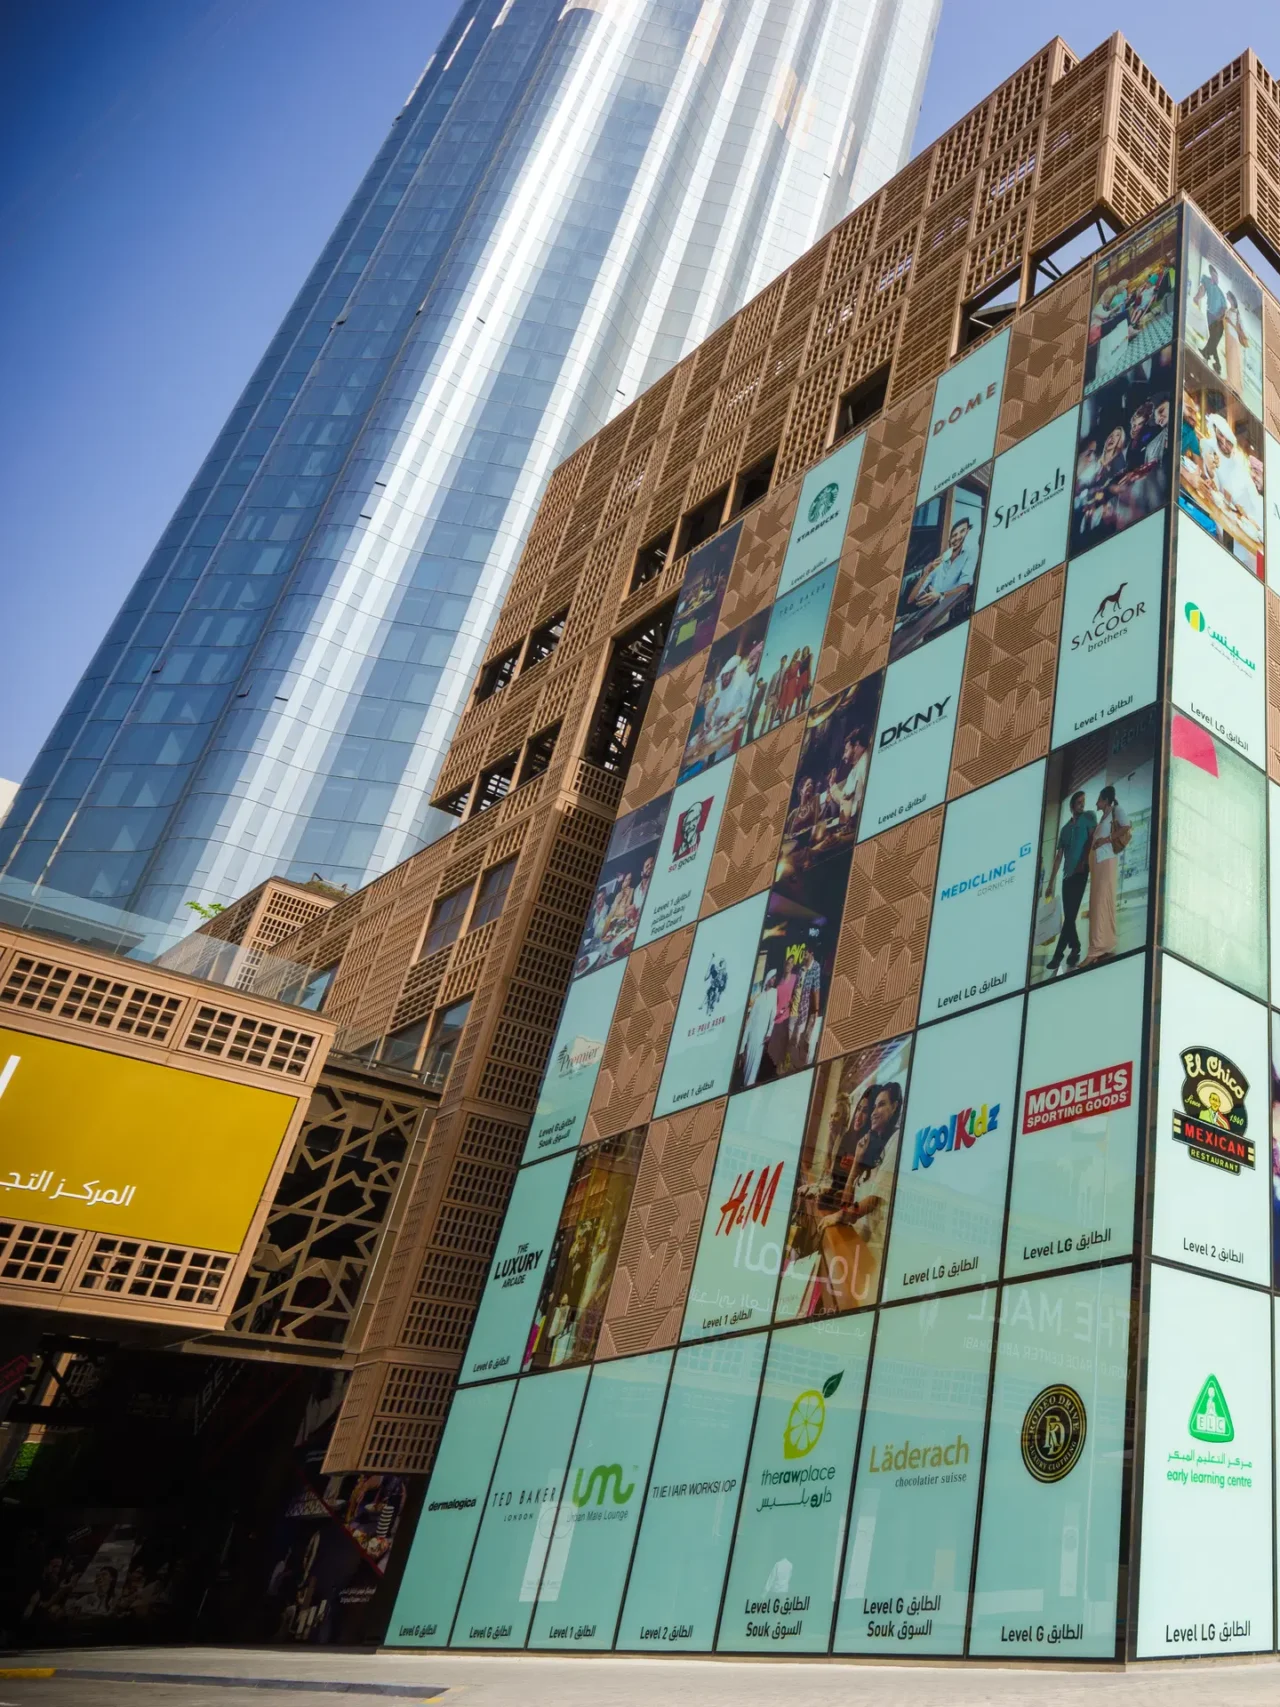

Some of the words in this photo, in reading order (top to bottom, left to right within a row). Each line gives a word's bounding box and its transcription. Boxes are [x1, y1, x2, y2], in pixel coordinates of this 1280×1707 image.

[933, 382, 997, 436] DOME
[992, 467, 1065, 529] Splash
[796, 511, 839, 544] STARBUCKS
[996, 577, 1016, 593] Level
[1071, 601, 1147, 651] SACOOR
[1088, 627, 1128, 652] brothers
[879, 695, 952, 749] DKNY
[1074, 714, 1098, 731] Level
[1107, 695, 1133, 716] الطابق
[1190, 702, 1213, 726] Level
[1215, 719, 1225, 736] LG
[1226, 730, 1249, 752] الطابق
[878, 809, 897, 825] Level
[905, 793, 927, 812] الطابق
[668, 864, 677, 873] so
[677, 853, 697, 871] good
[940, 860, 1016, 901] MEDICLINIC
[977, 876, 1016, 897] CORNICHE
[937, 990, 962, 1008] Level
[964, 985, 977, 999] LG
[979, 972, 1008, 994] الطابق
[560, 1046, 600, 1072] Premier
[1184, 1053, 1205, 1078] El
[1206, 1056, 1245, 1099] Chico
[673, 1088, 690, 1103] Level
[695, 1080, 715, 1096] الطابق
[1027, 1068, 1128, 1116] MODELL'S
[1027, 1104, 1083, 1128] SPORTING
[1085, 1091, 1127, 1113] GOODS
[1185, 1096, 1202, 1108] Since
[1229, 1113, 1245, 1126] 1940
[539, 1122, 555, 1138] Level
[912, 1103, 1000, 1171] KoolKidz
[1184, 1123, 1245, 1158] MEXICAN
[1191, 1148, 1239, 1173] RESTAURANT
[49, 1178, 136, 1206] المركز
[715, 1161, 784, 1237] H&M
[518, 1243, 530, 1254] THE
[1023, 1241, 1054, 1260] Level
[1056, 1238, 1073, 1253] LG
[1076, 1228, 1111, 1251] الطابق
[1183, 1237, 1209, 1256] Level
[1211, 1244, 1217, 1258] 2
[1218, 1248, 1244, 1265] الطابق
[494, 1249, 544, 1280] LUXURY
[903, 1271, 929, 1286] Level
[932, 1265, 945, 1280] LG
[948, 1256, 979, 1278] الطابق
[502, 1274, 527, 1289] ARCADE
[702, 1315, 722, 1330] Level
[730, 1309, 753, 1326] الطابق
[473, 1361, 488, 1373] Level
[493, 1355, 511, 1370] الطابق
[1029, 1395, 1056, 1434] RODEO
[1058, 1395, 1080, 1431] DRIVE
[869, 1434, 970, 1473] Läderach
[1029, 1444, 1047, 1470] LUXURY
[1048, 1440, 1077, 1472] CLOTHING
[1167, 1449, 1195, 1464] المبكر
[1195, 1451, 1226, 1467] التعليم
[1227, 1454, 1253, 1469] مركز
[761, 1464, 836, 1486] therawplace
[895, 1474, 939, 1488] chocolatier
[941, 1472, 967, 1484] suisse
[1166, 1470, 1189, 1486] early
[1190, 1470, 1225, 1489] learning
[1227, 1475, 1253, 1488] centre
[492, 1491, 513, 1507] TED
[519, 1487, 557, 1505] BAKER
[652, 1486, 668, 1498] THE
[668, 1484, 687, 1497] HAIR
[687, 1479, 737, 1496] WORKSHOP
[428, 1498, 477, 1512] dermalogica
[566, 1511, 586, 1523] Urban
[586, 1511, 603, 1522] Male
[603, 1509, 628, 1523] Lounge
[503, 1513, 534, 1522] LONDON
[744, 1598, 771, 1615] Level
[772, 1599, 779, 1614] G
[779, 1595, 811, 1616] الطابق
[863, 1597, 892, 1615] Level
[895, 1598, 904, 1614] G
[906, 1595, 941, 1616] الطابق
[399, 1625, 415, 1636] Level
[419, 1624, 437, 1638] الطابق
[469, 1626, 487, 1639] Level
[486, 1627, 492, 1638] G
[492, 1625, 512, 1640] الطابق
[549, 1626, 567, 1639] Level
[574, 1624, 596, 1640] الطابق
[640, 1626, 662, 1639] Level
[661, 1626, 668, 1639] 2
[669, 1625, 693, 1641] الطابق
[746, 1621, 770, 1637] Souk
[771, 1620, 803, 1640] السوق
[866, 1621, 894, 1638] Souk
[897, 1619, 932, 1640] السوق
[1001, 1626, 1033, 1643] Level
[1036, 1627, 1044, 1642] G
[1047, 1624, 1083, 1644] الطابق
[1165, 1624, 1198, 1642] Level
[1201, 1623, 1216, 1641] LG
[1219, 1620, 1250, 1642] الطابق
